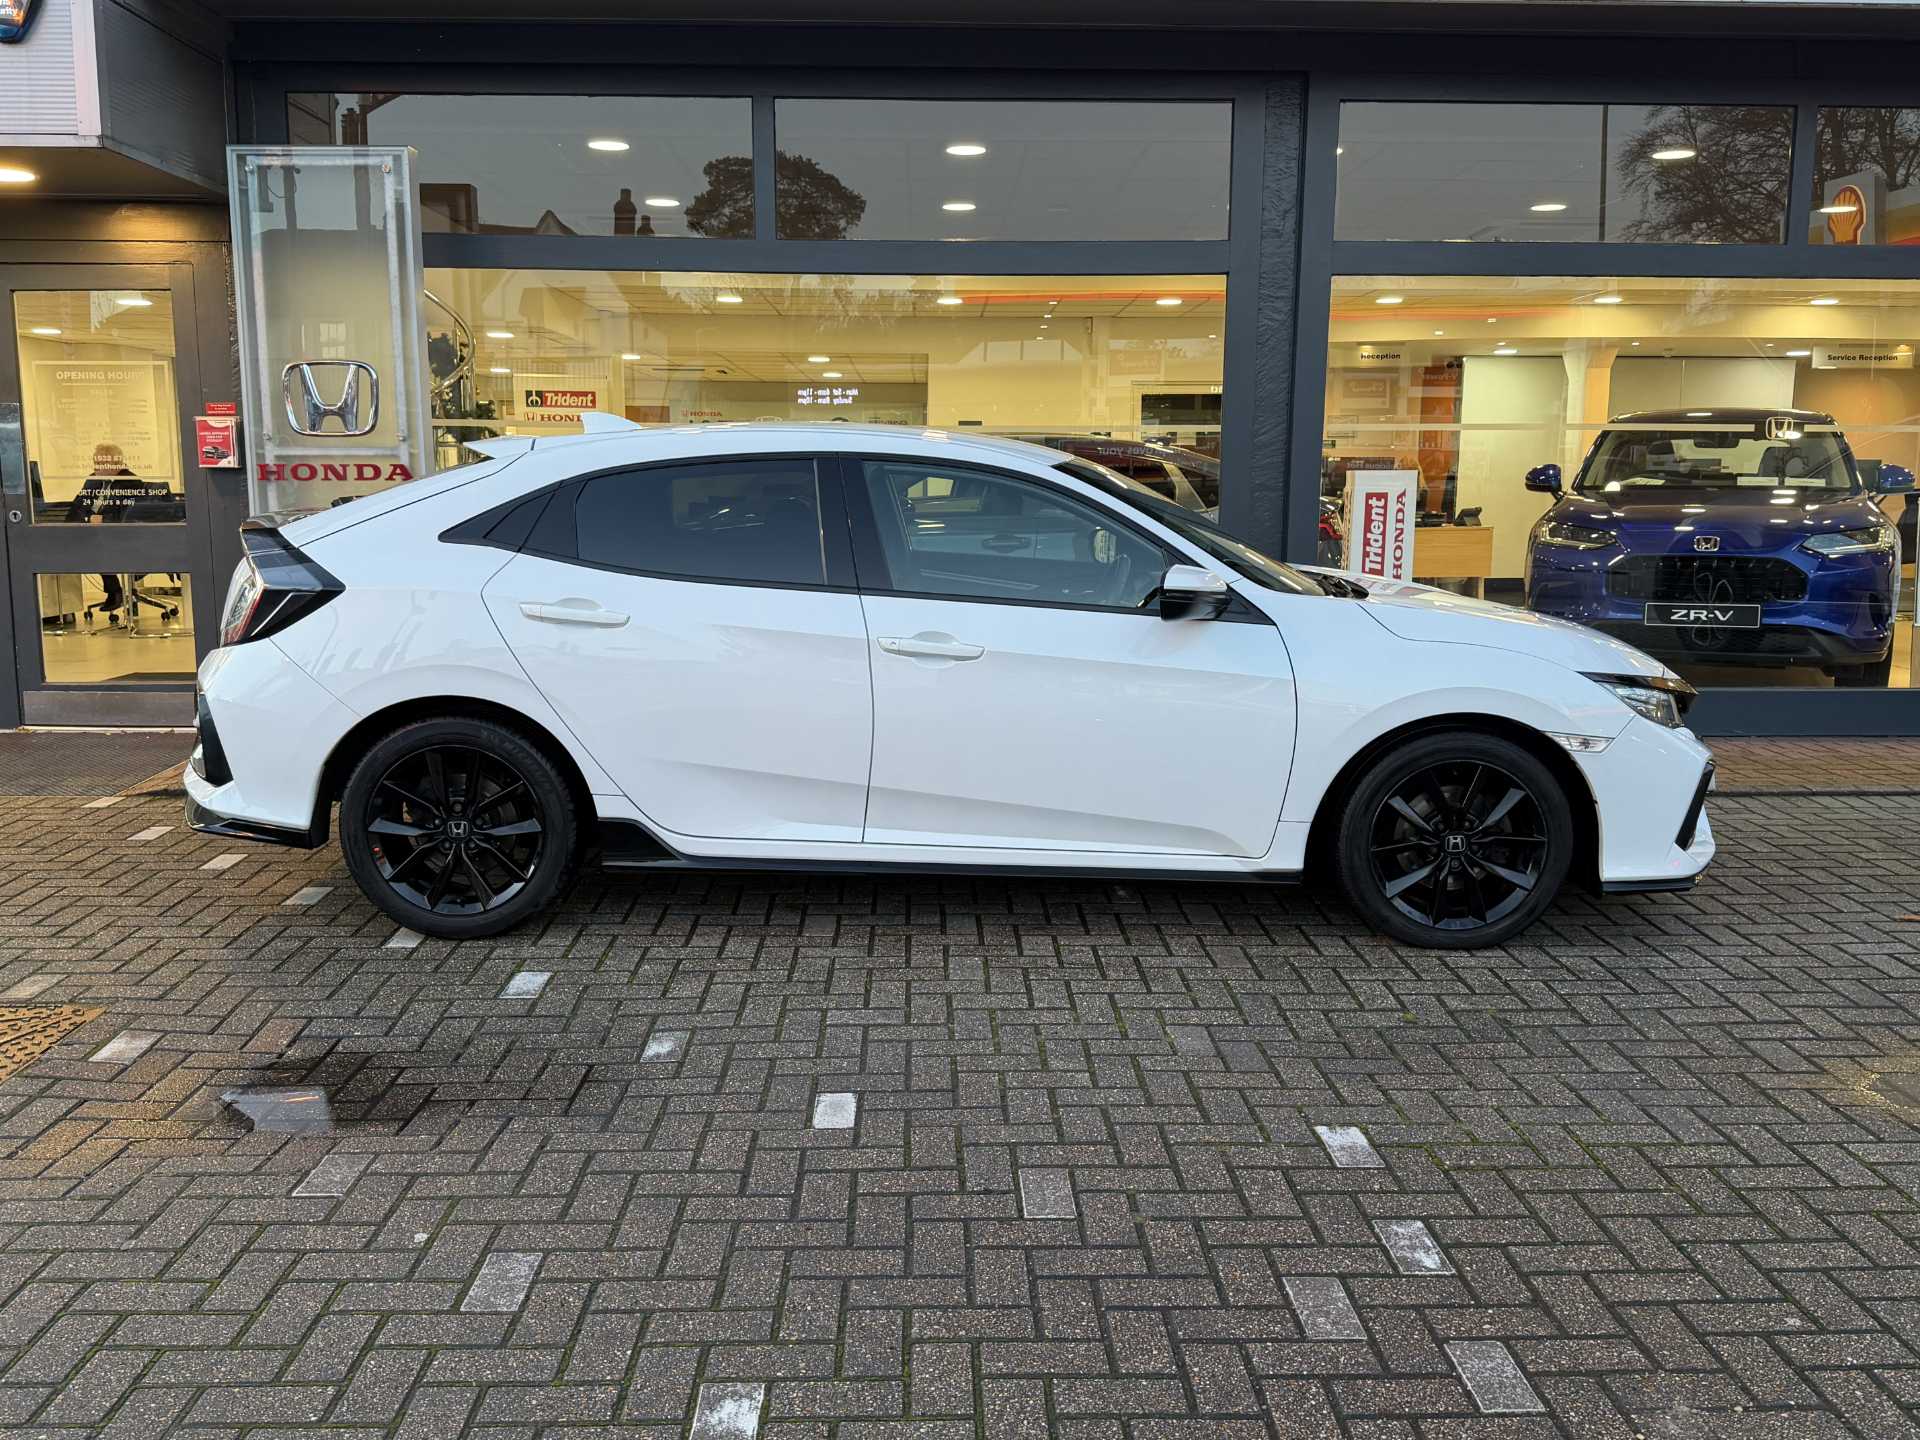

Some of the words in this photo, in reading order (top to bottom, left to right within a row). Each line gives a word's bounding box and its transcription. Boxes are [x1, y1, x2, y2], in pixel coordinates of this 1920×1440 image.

[1360, 352, 1401, 361] Reception
[1858, 354, 1898, 362] Reception
[55, 370, 105, 380] OPENING
[107, 370, 145, 380] HOU
[544, 391, 594, 407] Trident
[256, 463, 414, 481] HONDA
[148, 488, 168, 496] SHOP
[82, 498, 91, 506] 24
[93, 498, 113, 506] hours
[122, 498, 135, 508] day
[1364, 496, 1386, 573] Trident
[1392, 488, 1407, 580] HONDA
[1670, 609, 1734, 621] ZR-V
